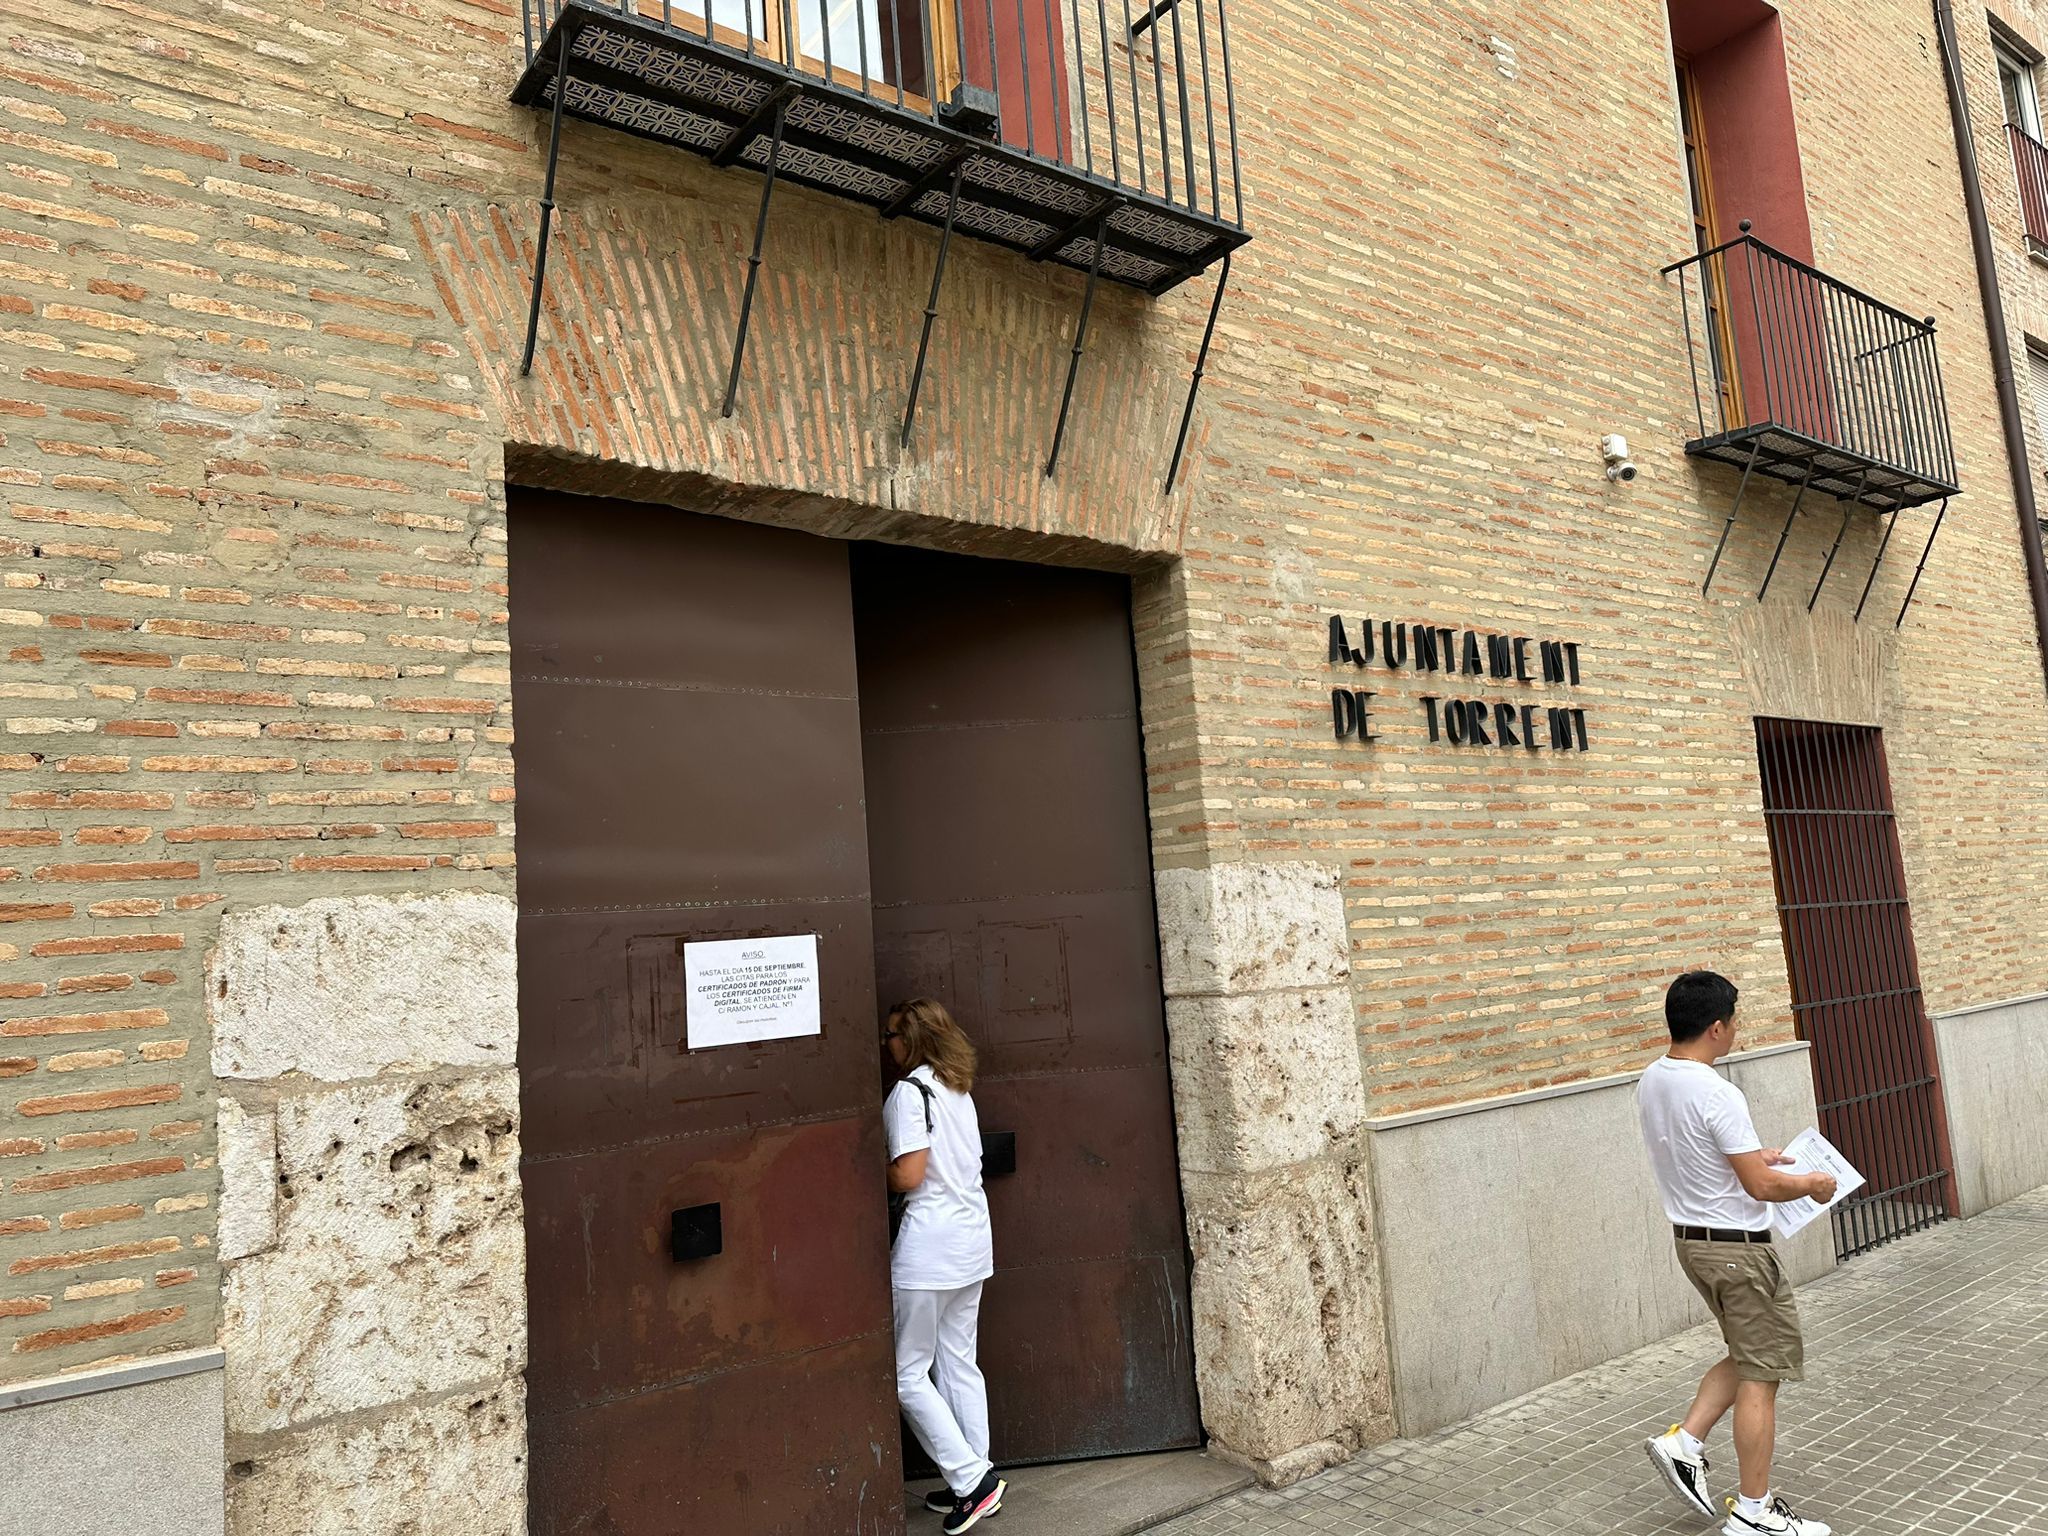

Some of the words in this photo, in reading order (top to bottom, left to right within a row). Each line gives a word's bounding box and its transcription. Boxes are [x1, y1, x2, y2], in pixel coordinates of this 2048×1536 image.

[1328, 614, 1582, 686] AJUNTAMENT
[1331, 688, 1383, 741] DE
[1418, 695, 1589, 752] TORRENT
[699, 969, 721, 977] HASTA
[721, 975, 735, 983] LAS
[697, 983, 747, 993] CERTIFICADOS
[706, 992, 720, 1000] LOS
[721, 988, 771, 998] CERTIFICADOS
[753, 994, 786, 1002] ATIENDEN
